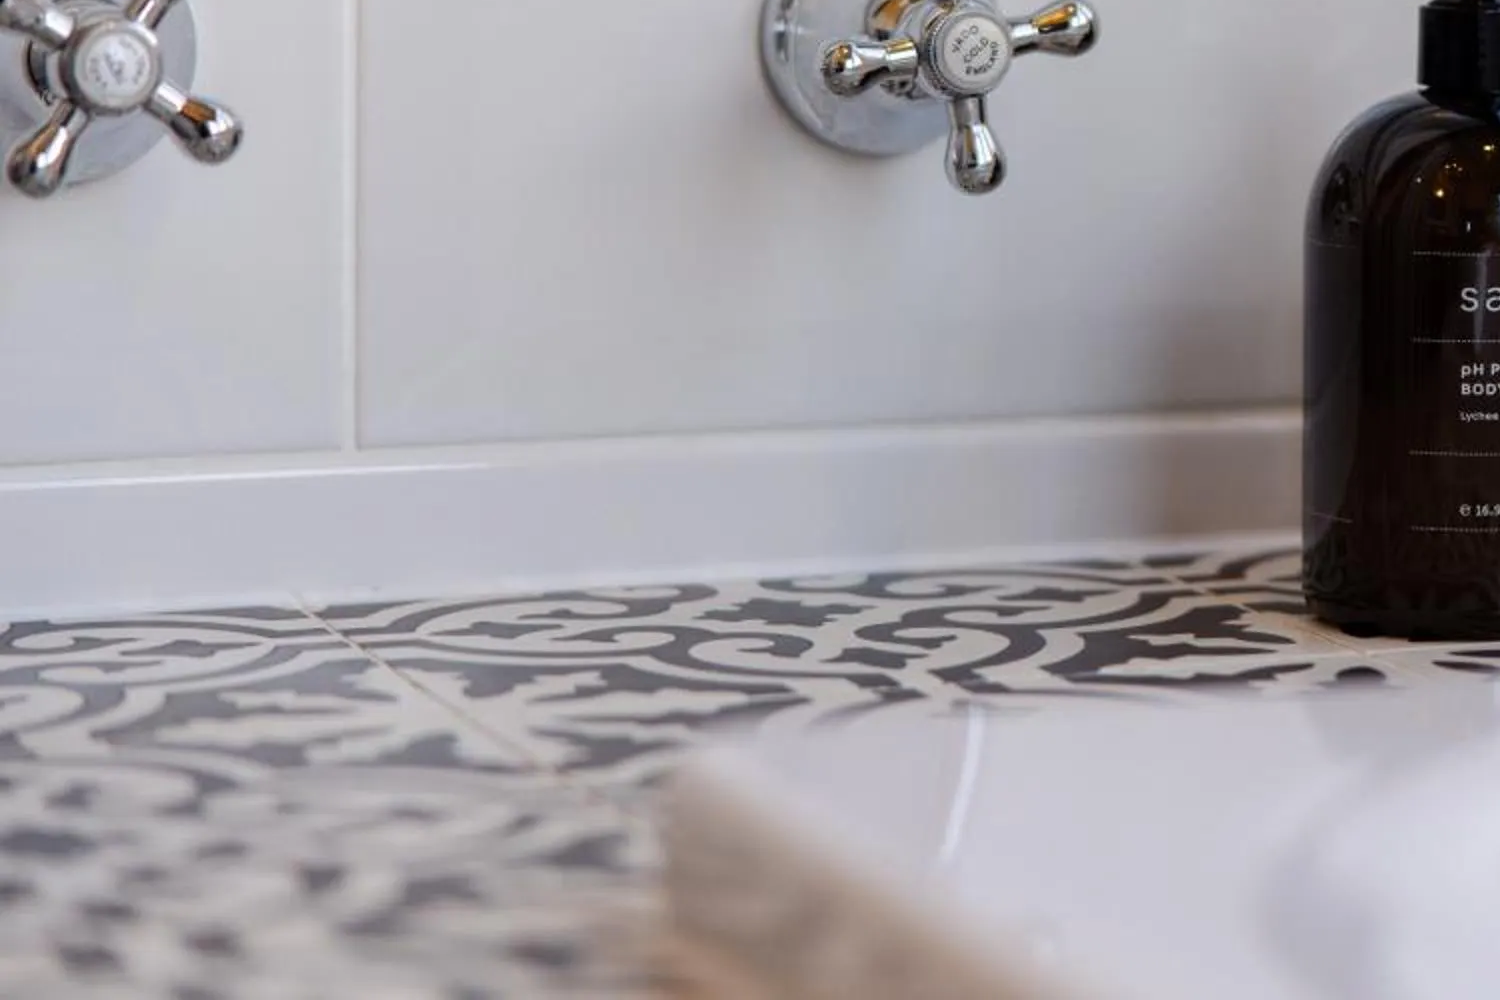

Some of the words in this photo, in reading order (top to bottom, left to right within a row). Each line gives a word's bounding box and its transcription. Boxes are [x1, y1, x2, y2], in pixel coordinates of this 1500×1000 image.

[963, 36, 989, 63] COLD
[1460, 363, 1485, 379] pH
[1459, 411, 1500, 423] Lychee
